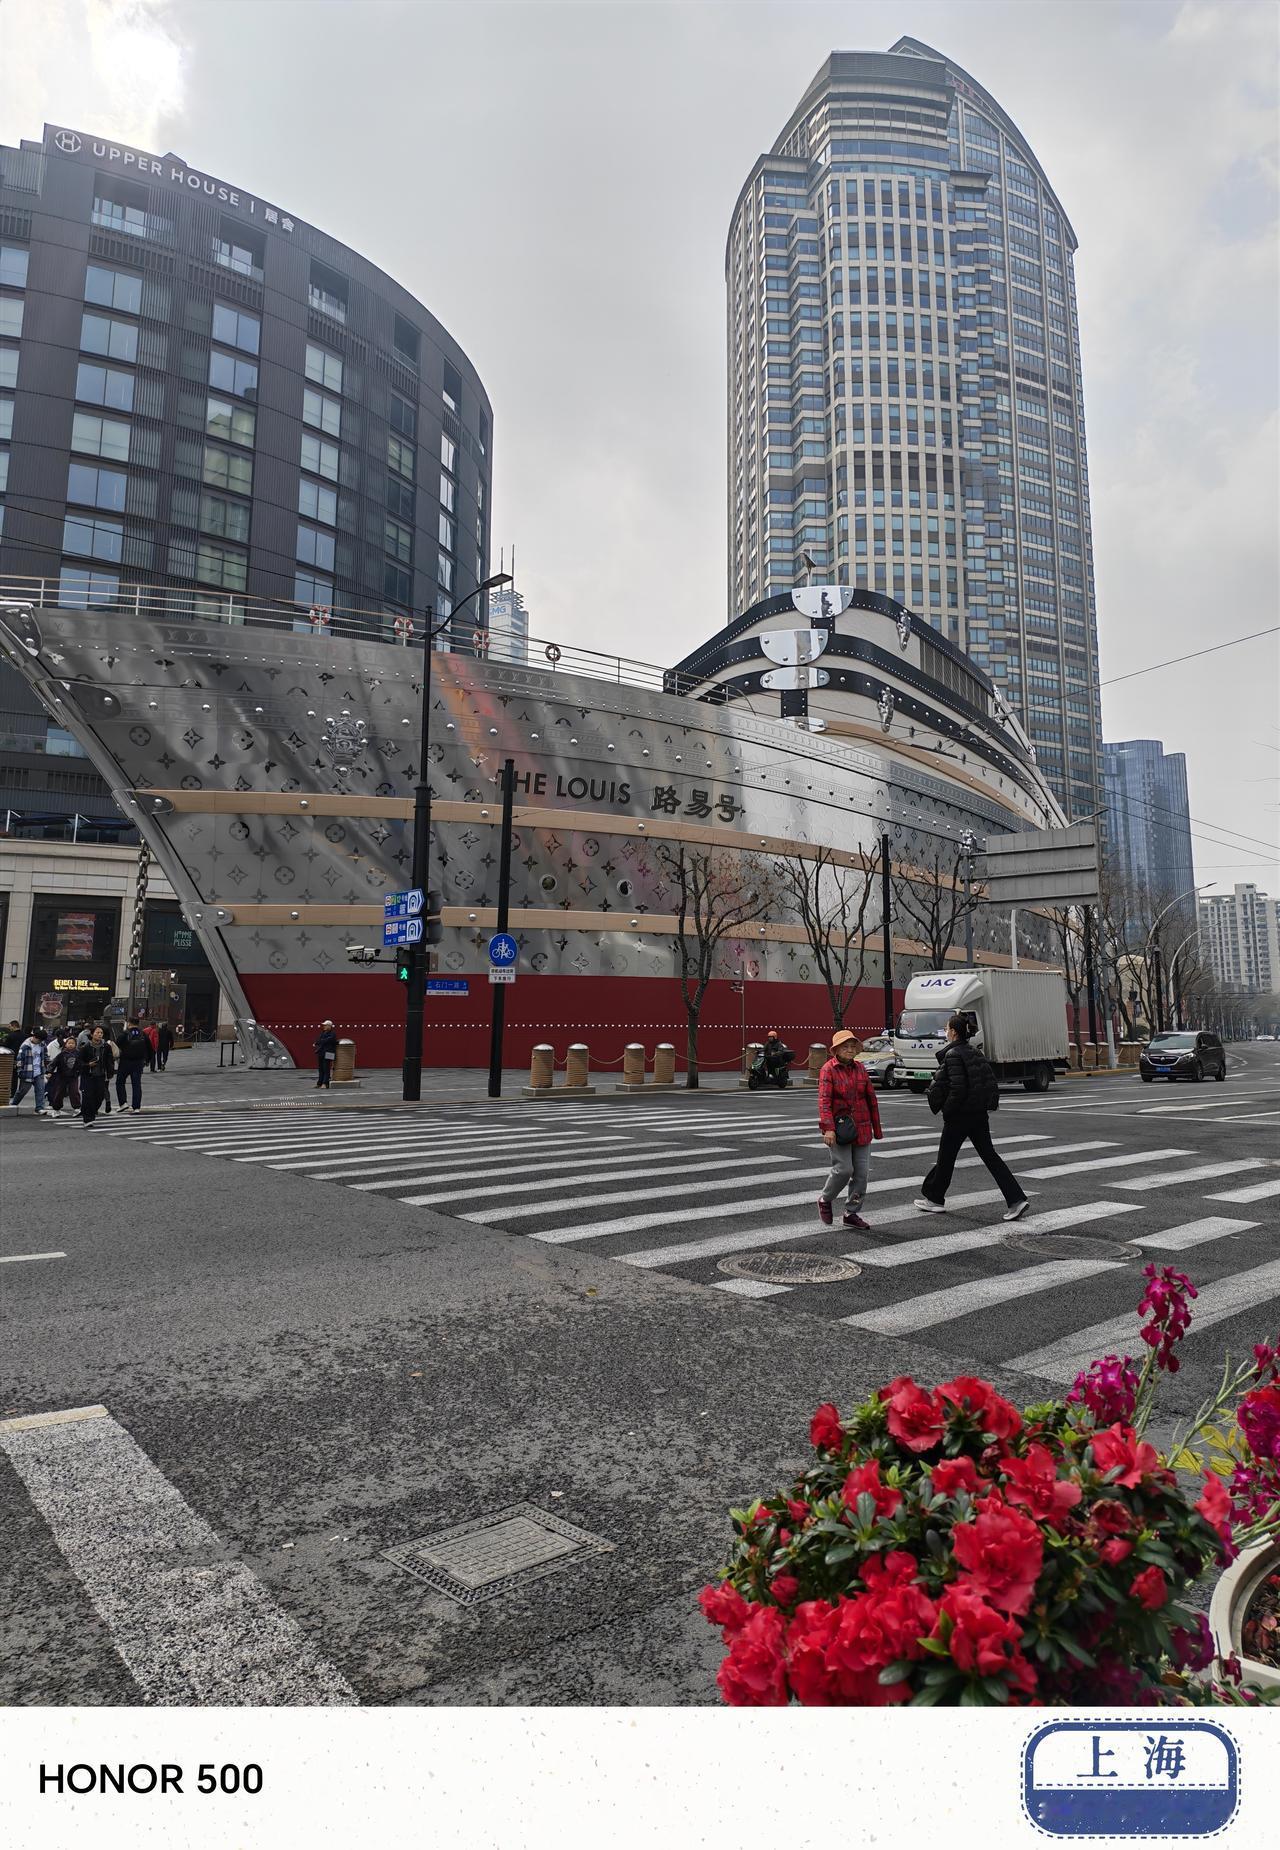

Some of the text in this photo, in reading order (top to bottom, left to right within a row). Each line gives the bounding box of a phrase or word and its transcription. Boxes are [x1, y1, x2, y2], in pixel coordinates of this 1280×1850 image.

[92, 142, 240, 206] UPPER HOUSE
[556, 775, 631, 804] LOUIS
[650, 784, 742, 823] 路易号
[920, 978, 956, 987] JAC
